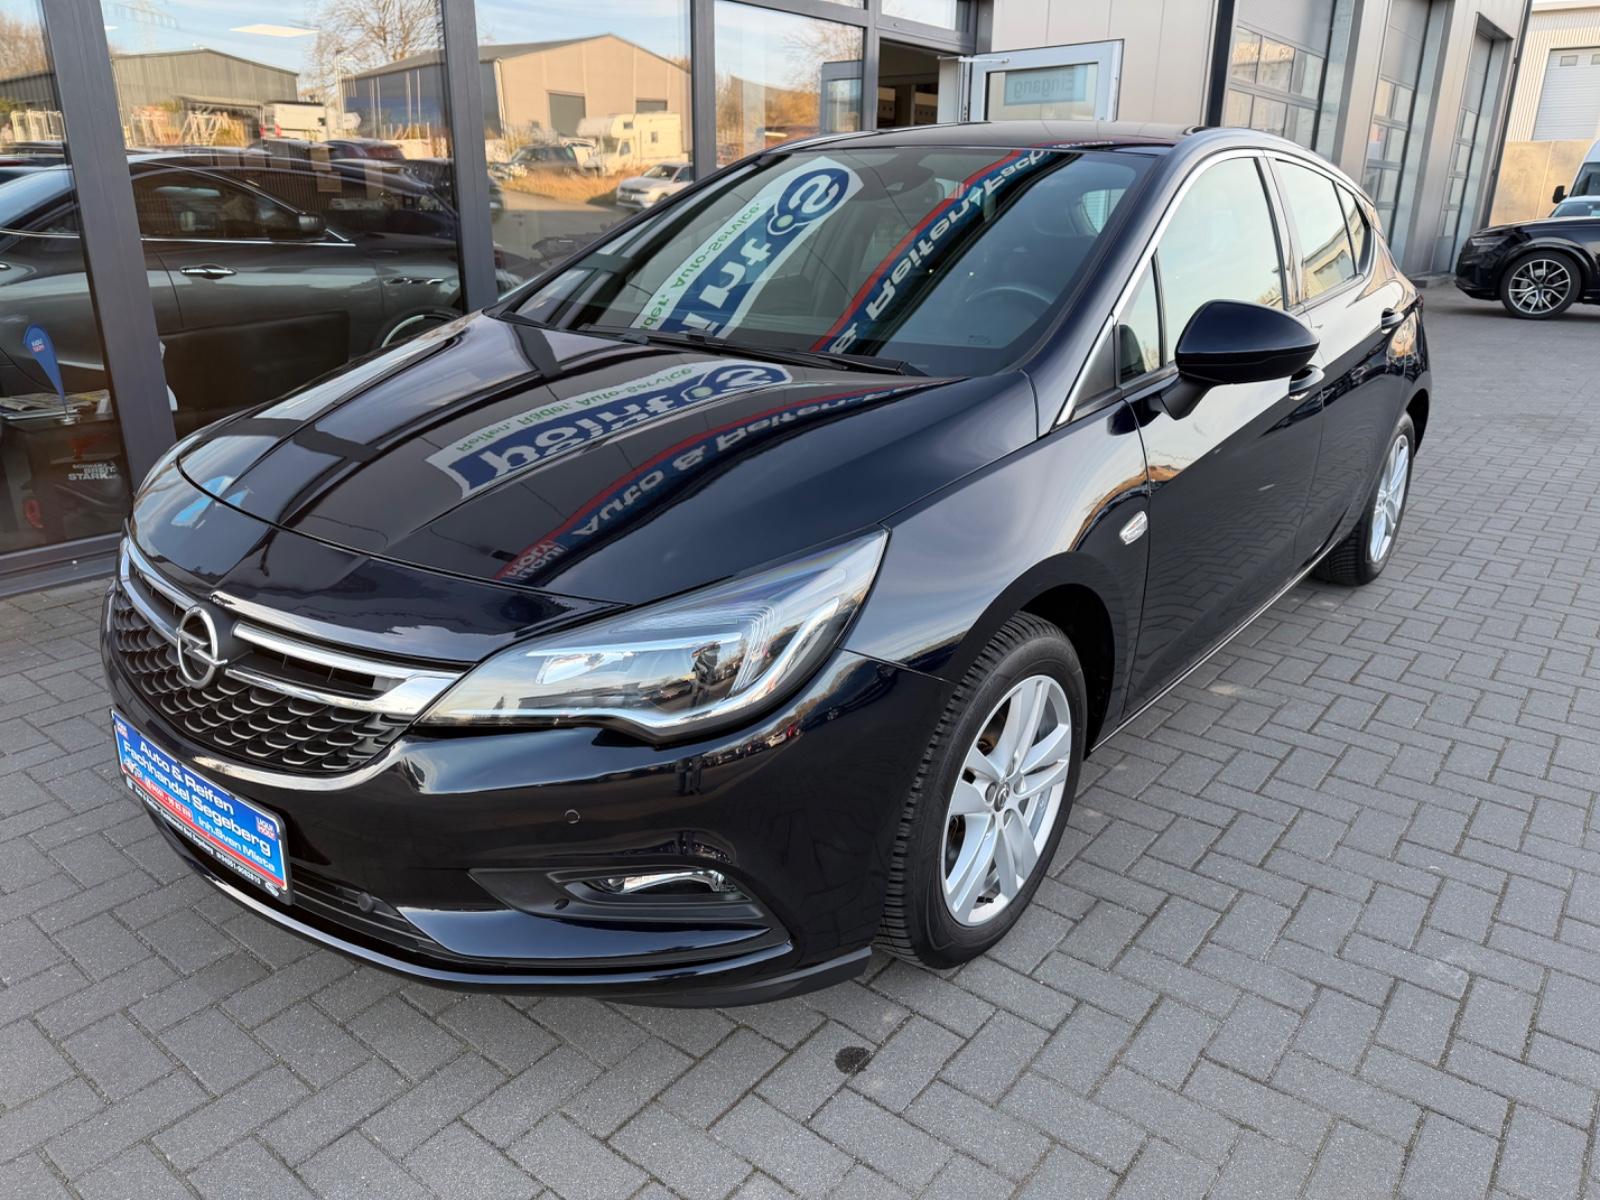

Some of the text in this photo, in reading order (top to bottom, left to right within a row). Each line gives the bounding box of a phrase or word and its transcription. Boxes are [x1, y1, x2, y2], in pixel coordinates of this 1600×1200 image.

[123, 739, 190, 803] Fachhandel
[191, 794, 272, 858] Segeberg
[140, 740, 170, 773] Auto
[171, 765, 184, 783] &
[184, 774, 235, 816] Reifen
